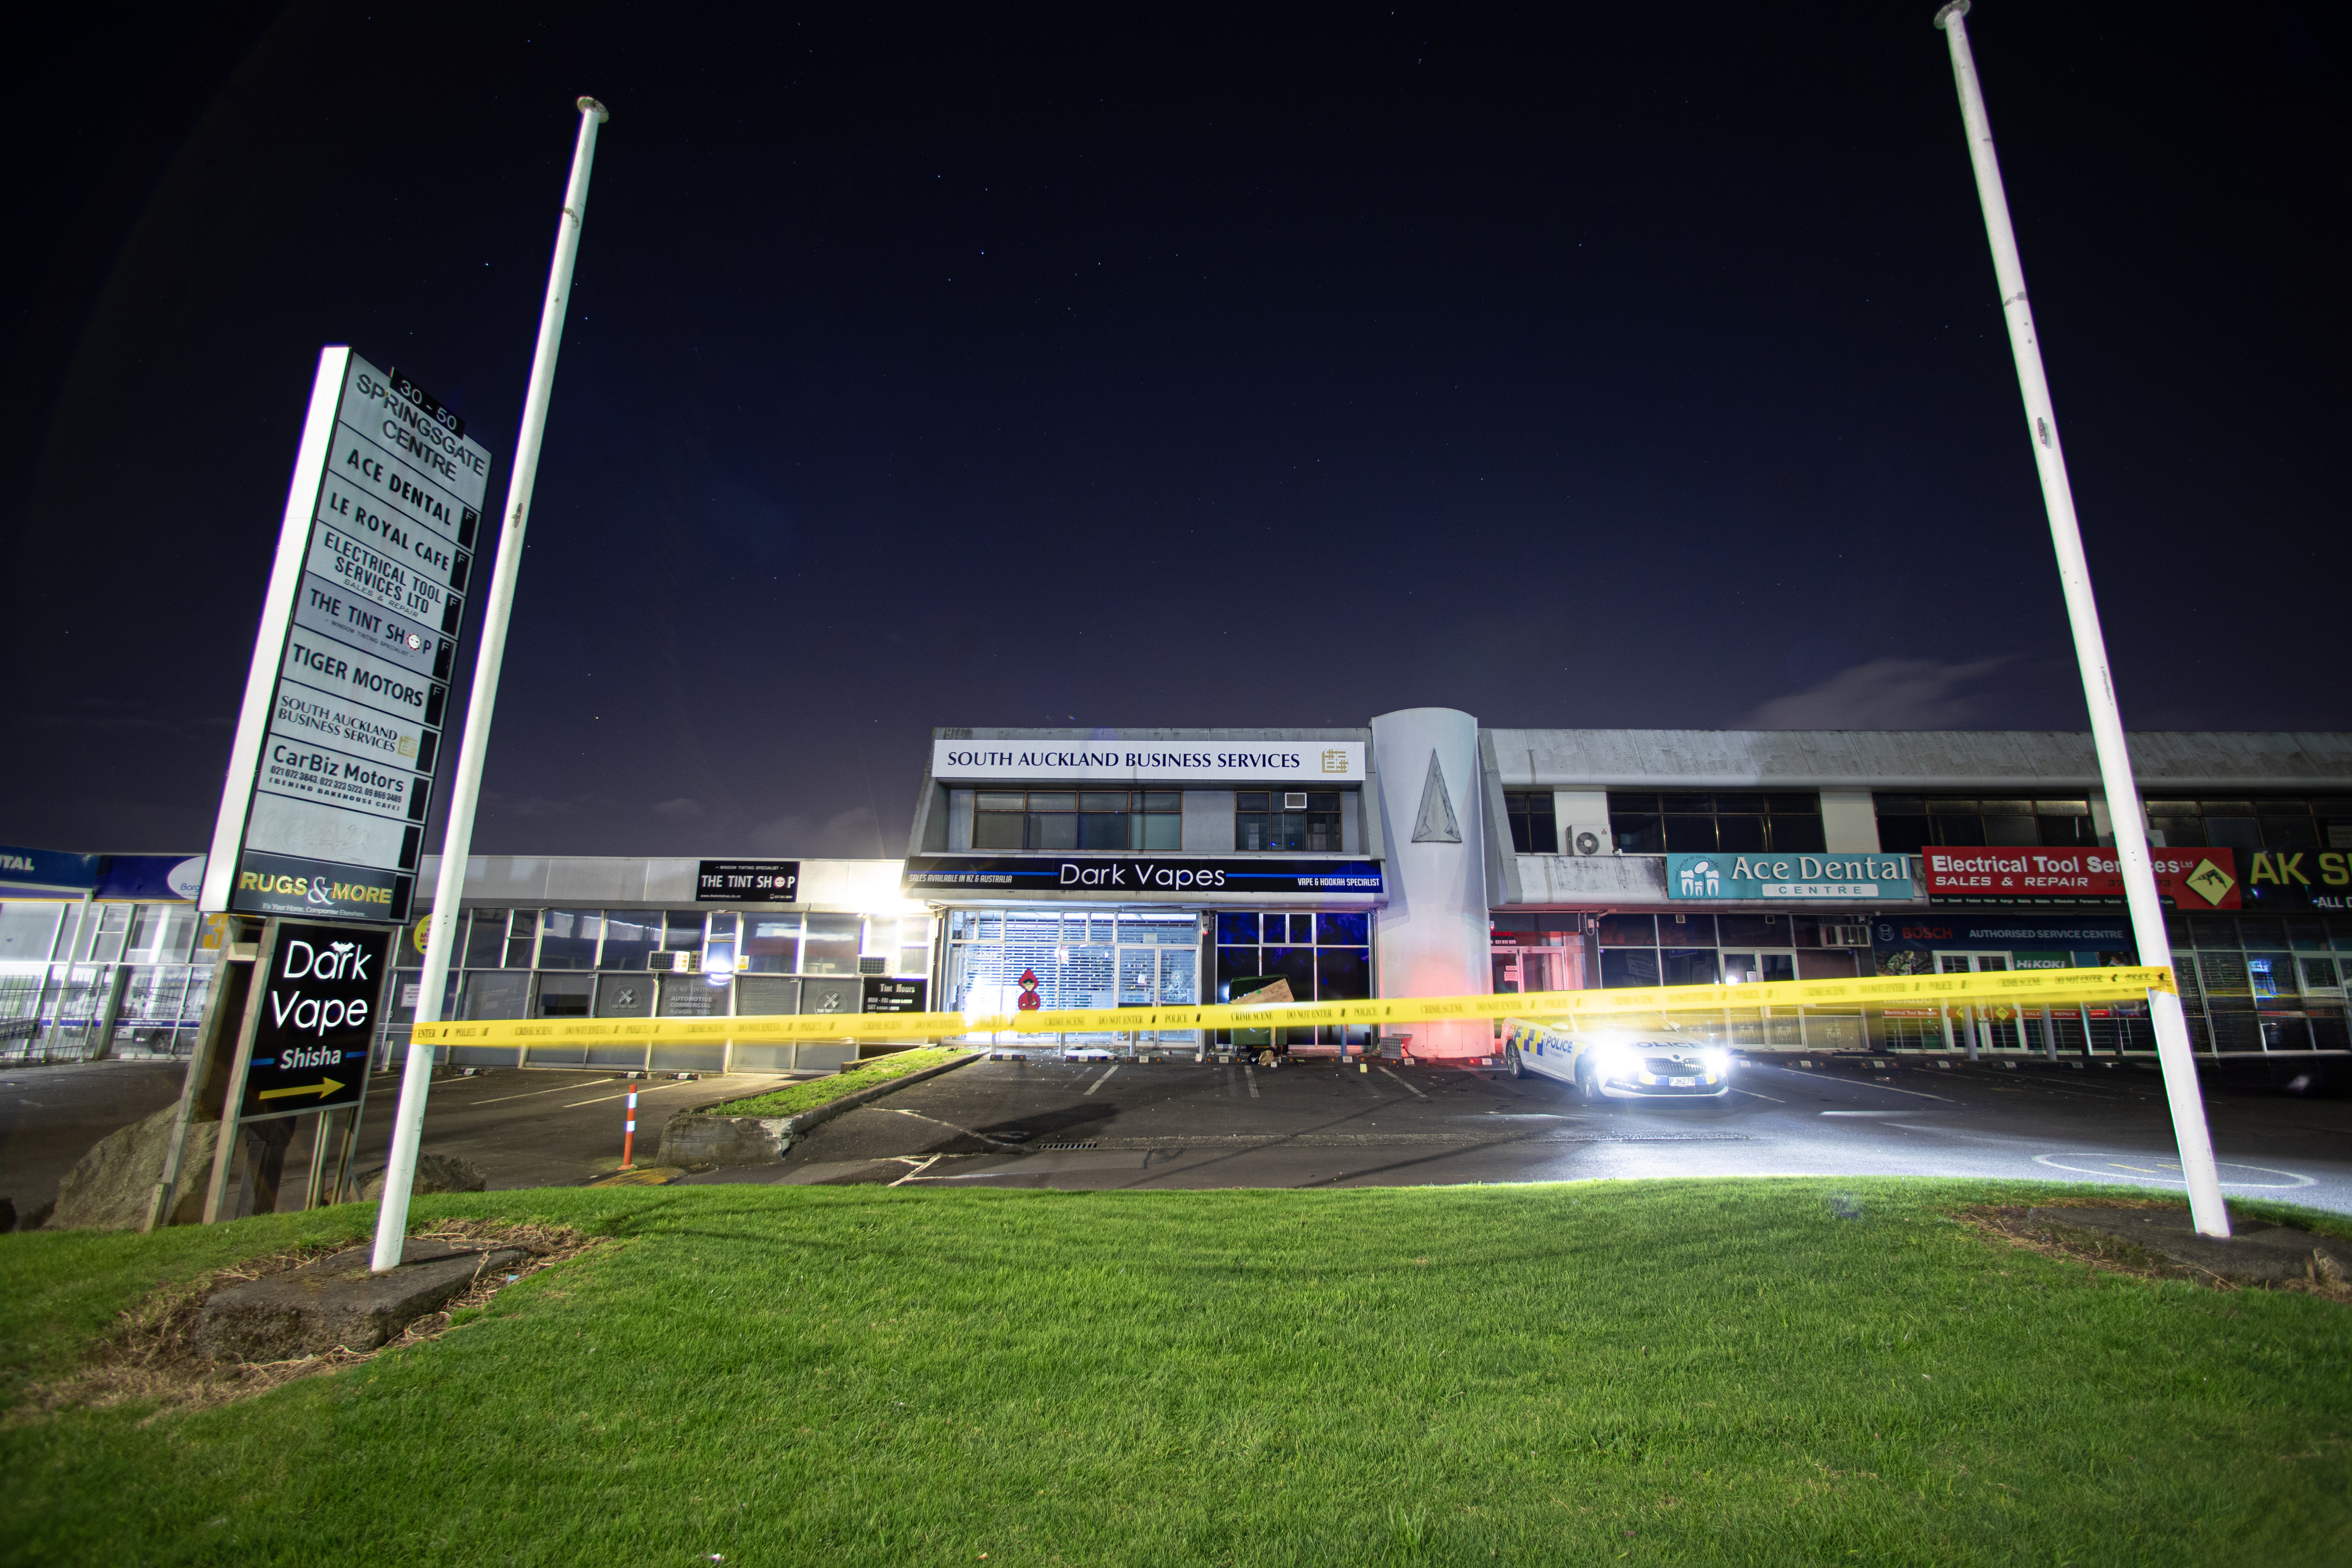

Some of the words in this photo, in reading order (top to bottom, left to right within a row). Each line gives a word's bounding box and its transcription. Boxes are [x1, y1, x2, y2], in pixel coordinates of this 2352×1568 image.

[400, 380, 423, 405] 30
[436, 408, 458, 431] 50
[356, 374, 485, 477] SPRINGSGATE
[382, 420, 456, 482] CENTRE
[347, 448, 383, 484] ACE
[389, 473, 451, 526] DENTAL
[331, 492, 350, 516] LE
[355, 508, 409, 551] ROYAL
[414, 541, 450, 572] CAFE
[324, 531, 407, 587] ELECTRICAL
[413, 576, 441, 604] TOOL
[335, 556, 402, 601] SERVICES
[407, 591, 429, 614] LTD
[344, 579, 374, 597] SALES
[389, 600, 419, 618] REPAIR
[310, 588, 342, 617] THE
[349, 605, 383, 634] TINT
[331, 620, 355, 634] WINDOW
[357, 631, 379, 644] TINTING
[380, 640, 409, 657] SPECIALIST
[293, 643, 348, 680] TIGER
[353, 668, 424, 708] MOTORS
[278, 708, 341, 736] BUSINESS
[343, 727, 395, 752] SERVICES
[280, 695, 330, 720] SOUTH
[332, 710, 398, 741] AUCKLAND
[273, 744, 340, 777] CarBiz
[344, 762, 405, 793] Motors
[948, 751, 1013, 766] SOUTH
[1018, 752, 1118, 766] AUCKLAND
[1126, 753, 1211, 768] BUSINESS
[1218, 753, 1300, 768] SERVICES
[271, 766, 285, 775] 021
[285, 769, 298, 779] 072
[321, 777, 333, 787] 022
[334, 780, 346, 790] 323
[364, 787, 373, 796] 09
[317, 787, 372, 805] BAKEHOUSE
[928, 874, 959, 882] AVAILABLE
[980, 875, 1012, 883] AUSTRALIA
[1060, 864, 1126, 885] Dark
[1135, 864, 1225, 890] Vapes
[1730, 856, 1790, 880] Ace
[1798, 856, 1910, 880] Dental
[1932, 855, 2027, 873] Electrical
[2033, 856, 2079, 873] Tool
[2087, 856, 2180, 873] Seres
[2250, 853, 2312, 884] AK
[181, 883, 201, 893] Barg
[701, 875, 723, 887] THE
[728, 875, 753, 887] TINT
[1298, 878, 1313, 886] VAPE
[1320, 878, 1345, 886] HOOKAH
[1347, 878, 1380, 886] SPECIALIST
[1778, 885, 1862, 895] CENTRE
[1936, 877, 1991, 886] SALES
[2002, 877, 2013, 886] &
[2025, 877, 2089, 887] REPAIR
[272, 903, 287, 912] Your
[306, 906, 340, 916] Compromise
[1902, 927, 1954, 939] BOSCH
[1969, 929, 2036, 938] AUTHORISED
[2037, 929, 2080, 938] SERVICE
[2082, 930, 2124, 939] CENTRE
[283, 940, 373, 980] Dark
[2016, 960, 2066, 969] HiKOKI
[880, 983, 893, 992] Tint
[896, 983, 916, 993] Hours
[272, 990, 368, 1037] Vape
[418, 1029, 436, 1038] ENTER
[456, 1028, 477, 1036] POLICE
[1045, 1017, 1064, 1026] CRIME
[1066, 1016, 1085, 1026] SCENE
[1099, 1016, 1108, 1025] DO
[1109, 1016, 1122, 1025] NOT
[1123, 1015, 1143, 1024] ENTER
[1165, 1014, 1188, 1023] POLICE
[1231, 1012, 1252, 1021] CRIME
[1253, 1011, 1273, 1020] SCENE
[1286, 1010, 1295, 1019] DO
[1297, 1010, 1310, 1019] NOT
[1311, 1008, 1332, 1018] ENTER
[1354, 1007, 1378, 1017] POLICE
[2081, 974, 2103, 983] ENTER
[279, 1045, 342, 1070] Shisha
[1546, 1035, 1573, 1054] POLICE
